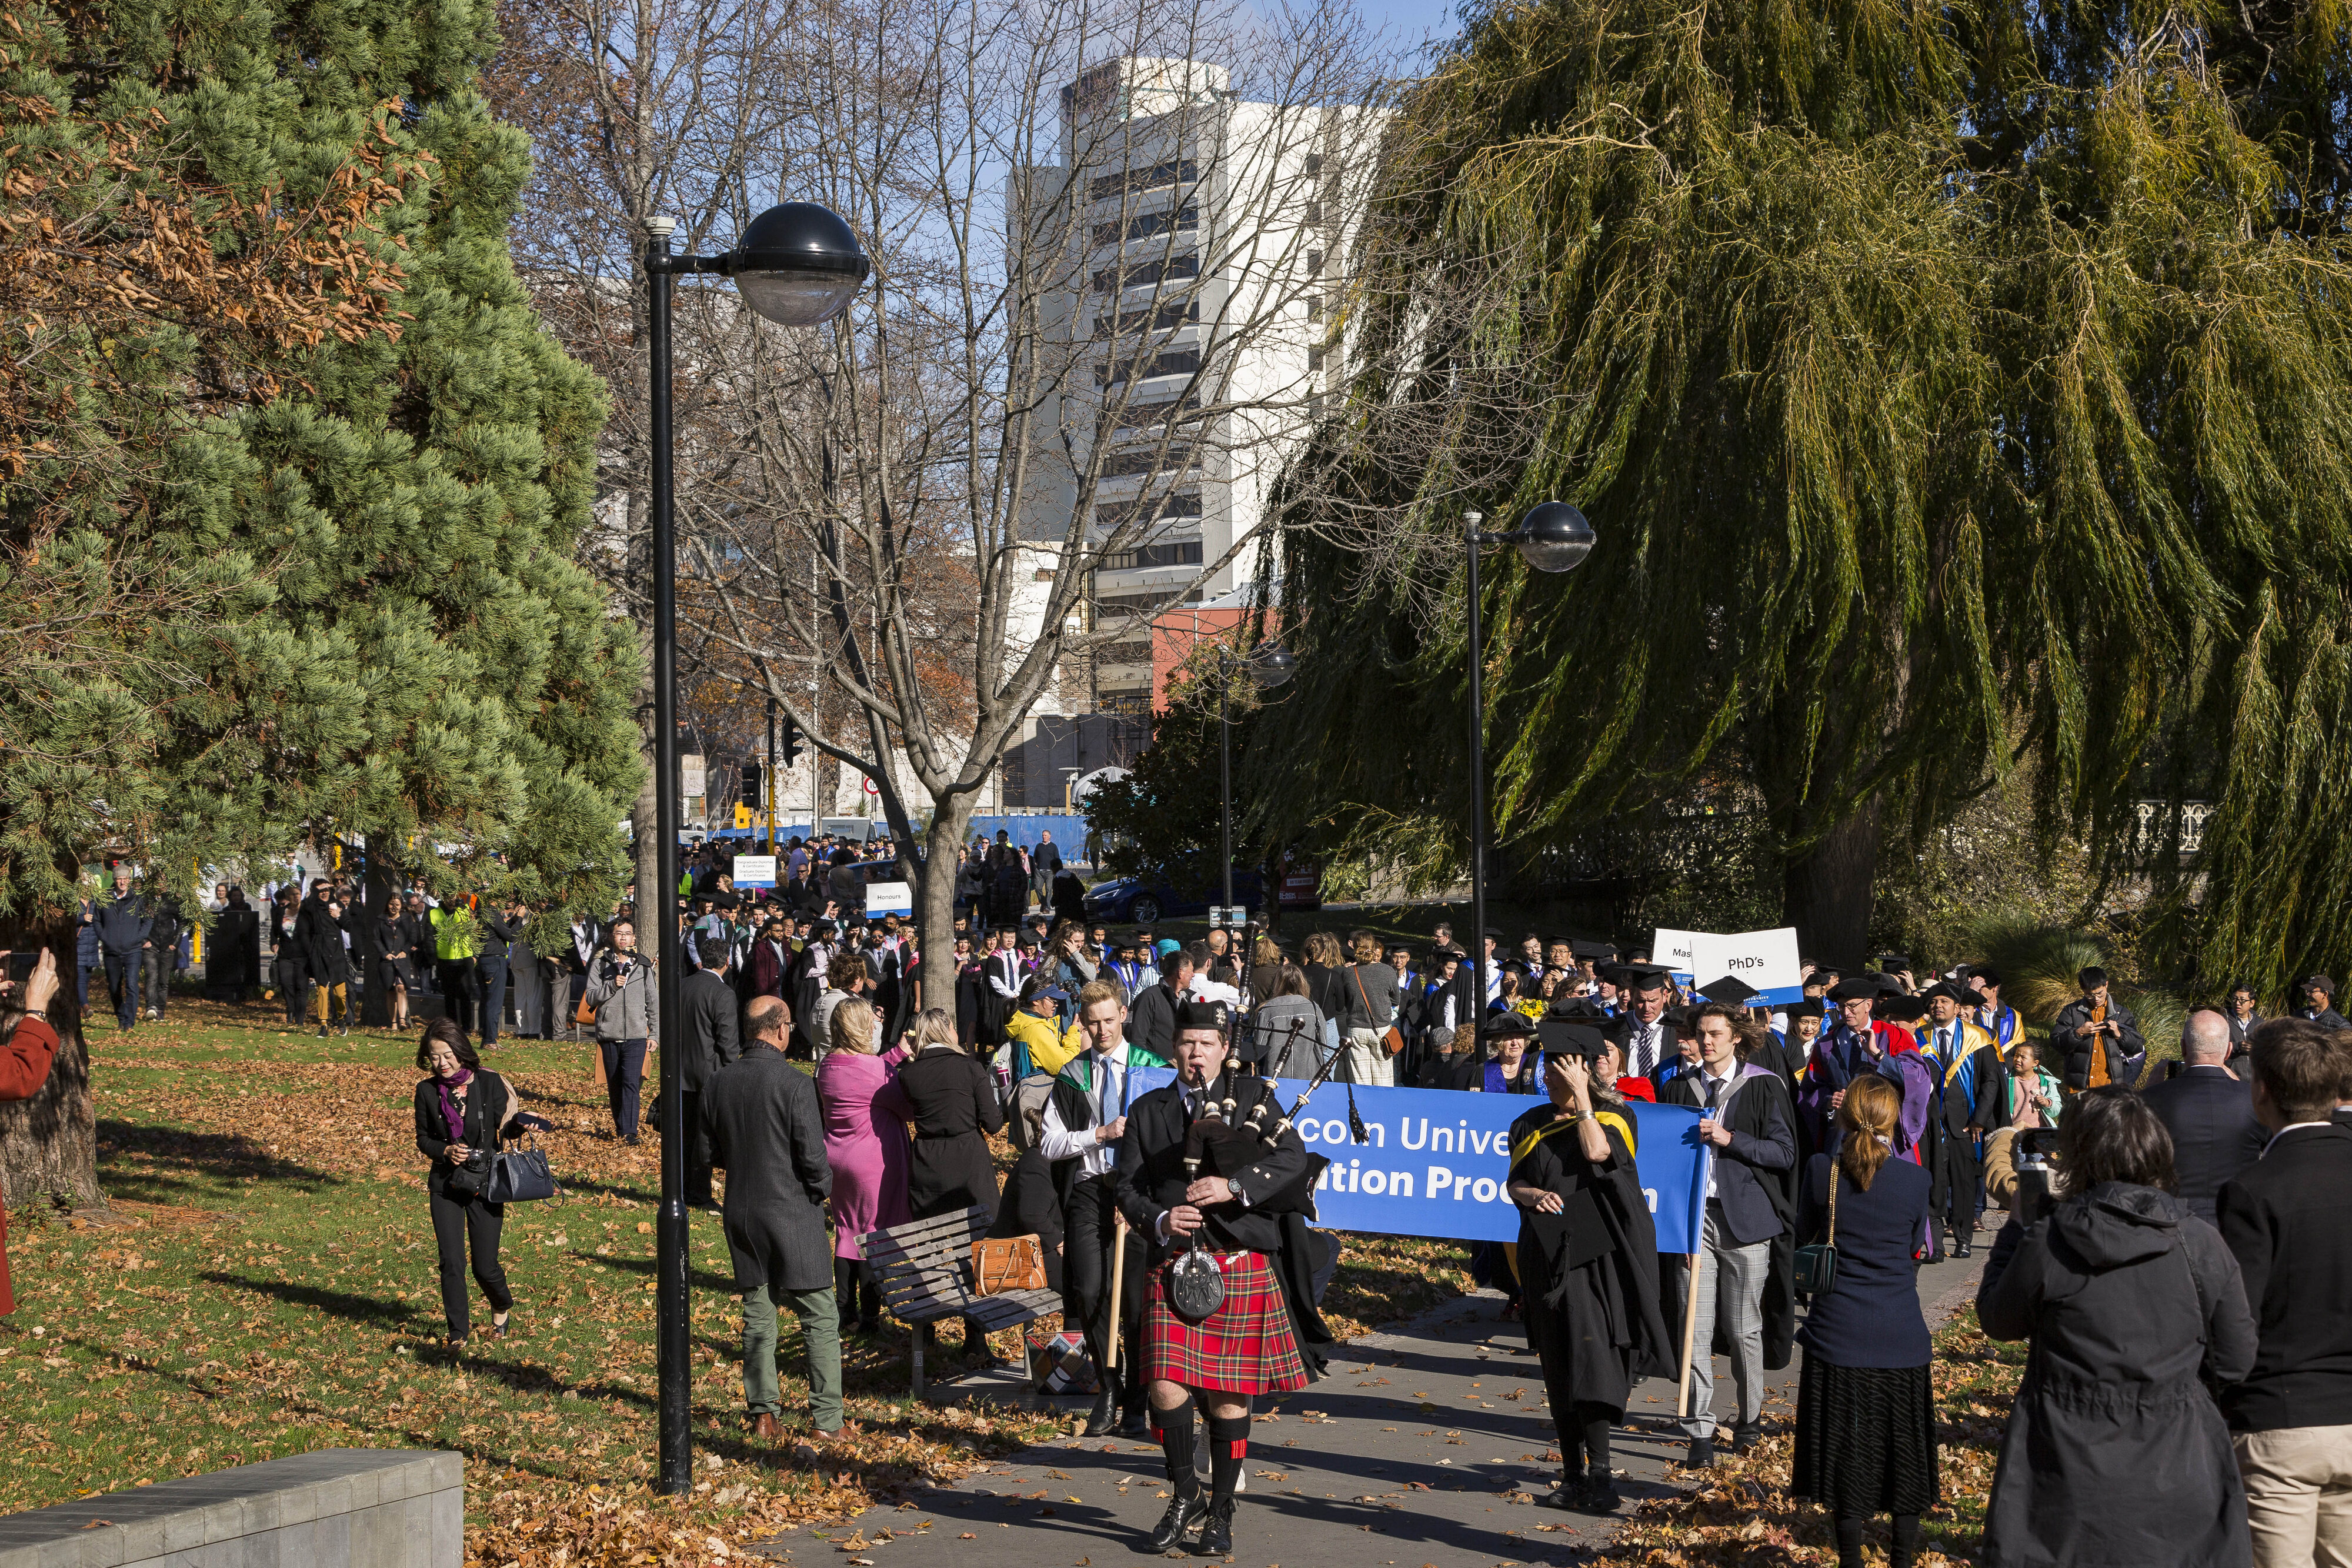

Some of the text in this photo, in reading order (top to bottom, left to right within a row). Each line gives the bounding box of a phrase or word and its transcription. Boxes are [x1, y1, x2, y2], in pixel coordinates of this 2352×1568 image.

[1673, 948, 1691, 958] Mas
[1729, 956, 1764, 970] PhD's
[1400, 1116, 1510, 1157] Unive
